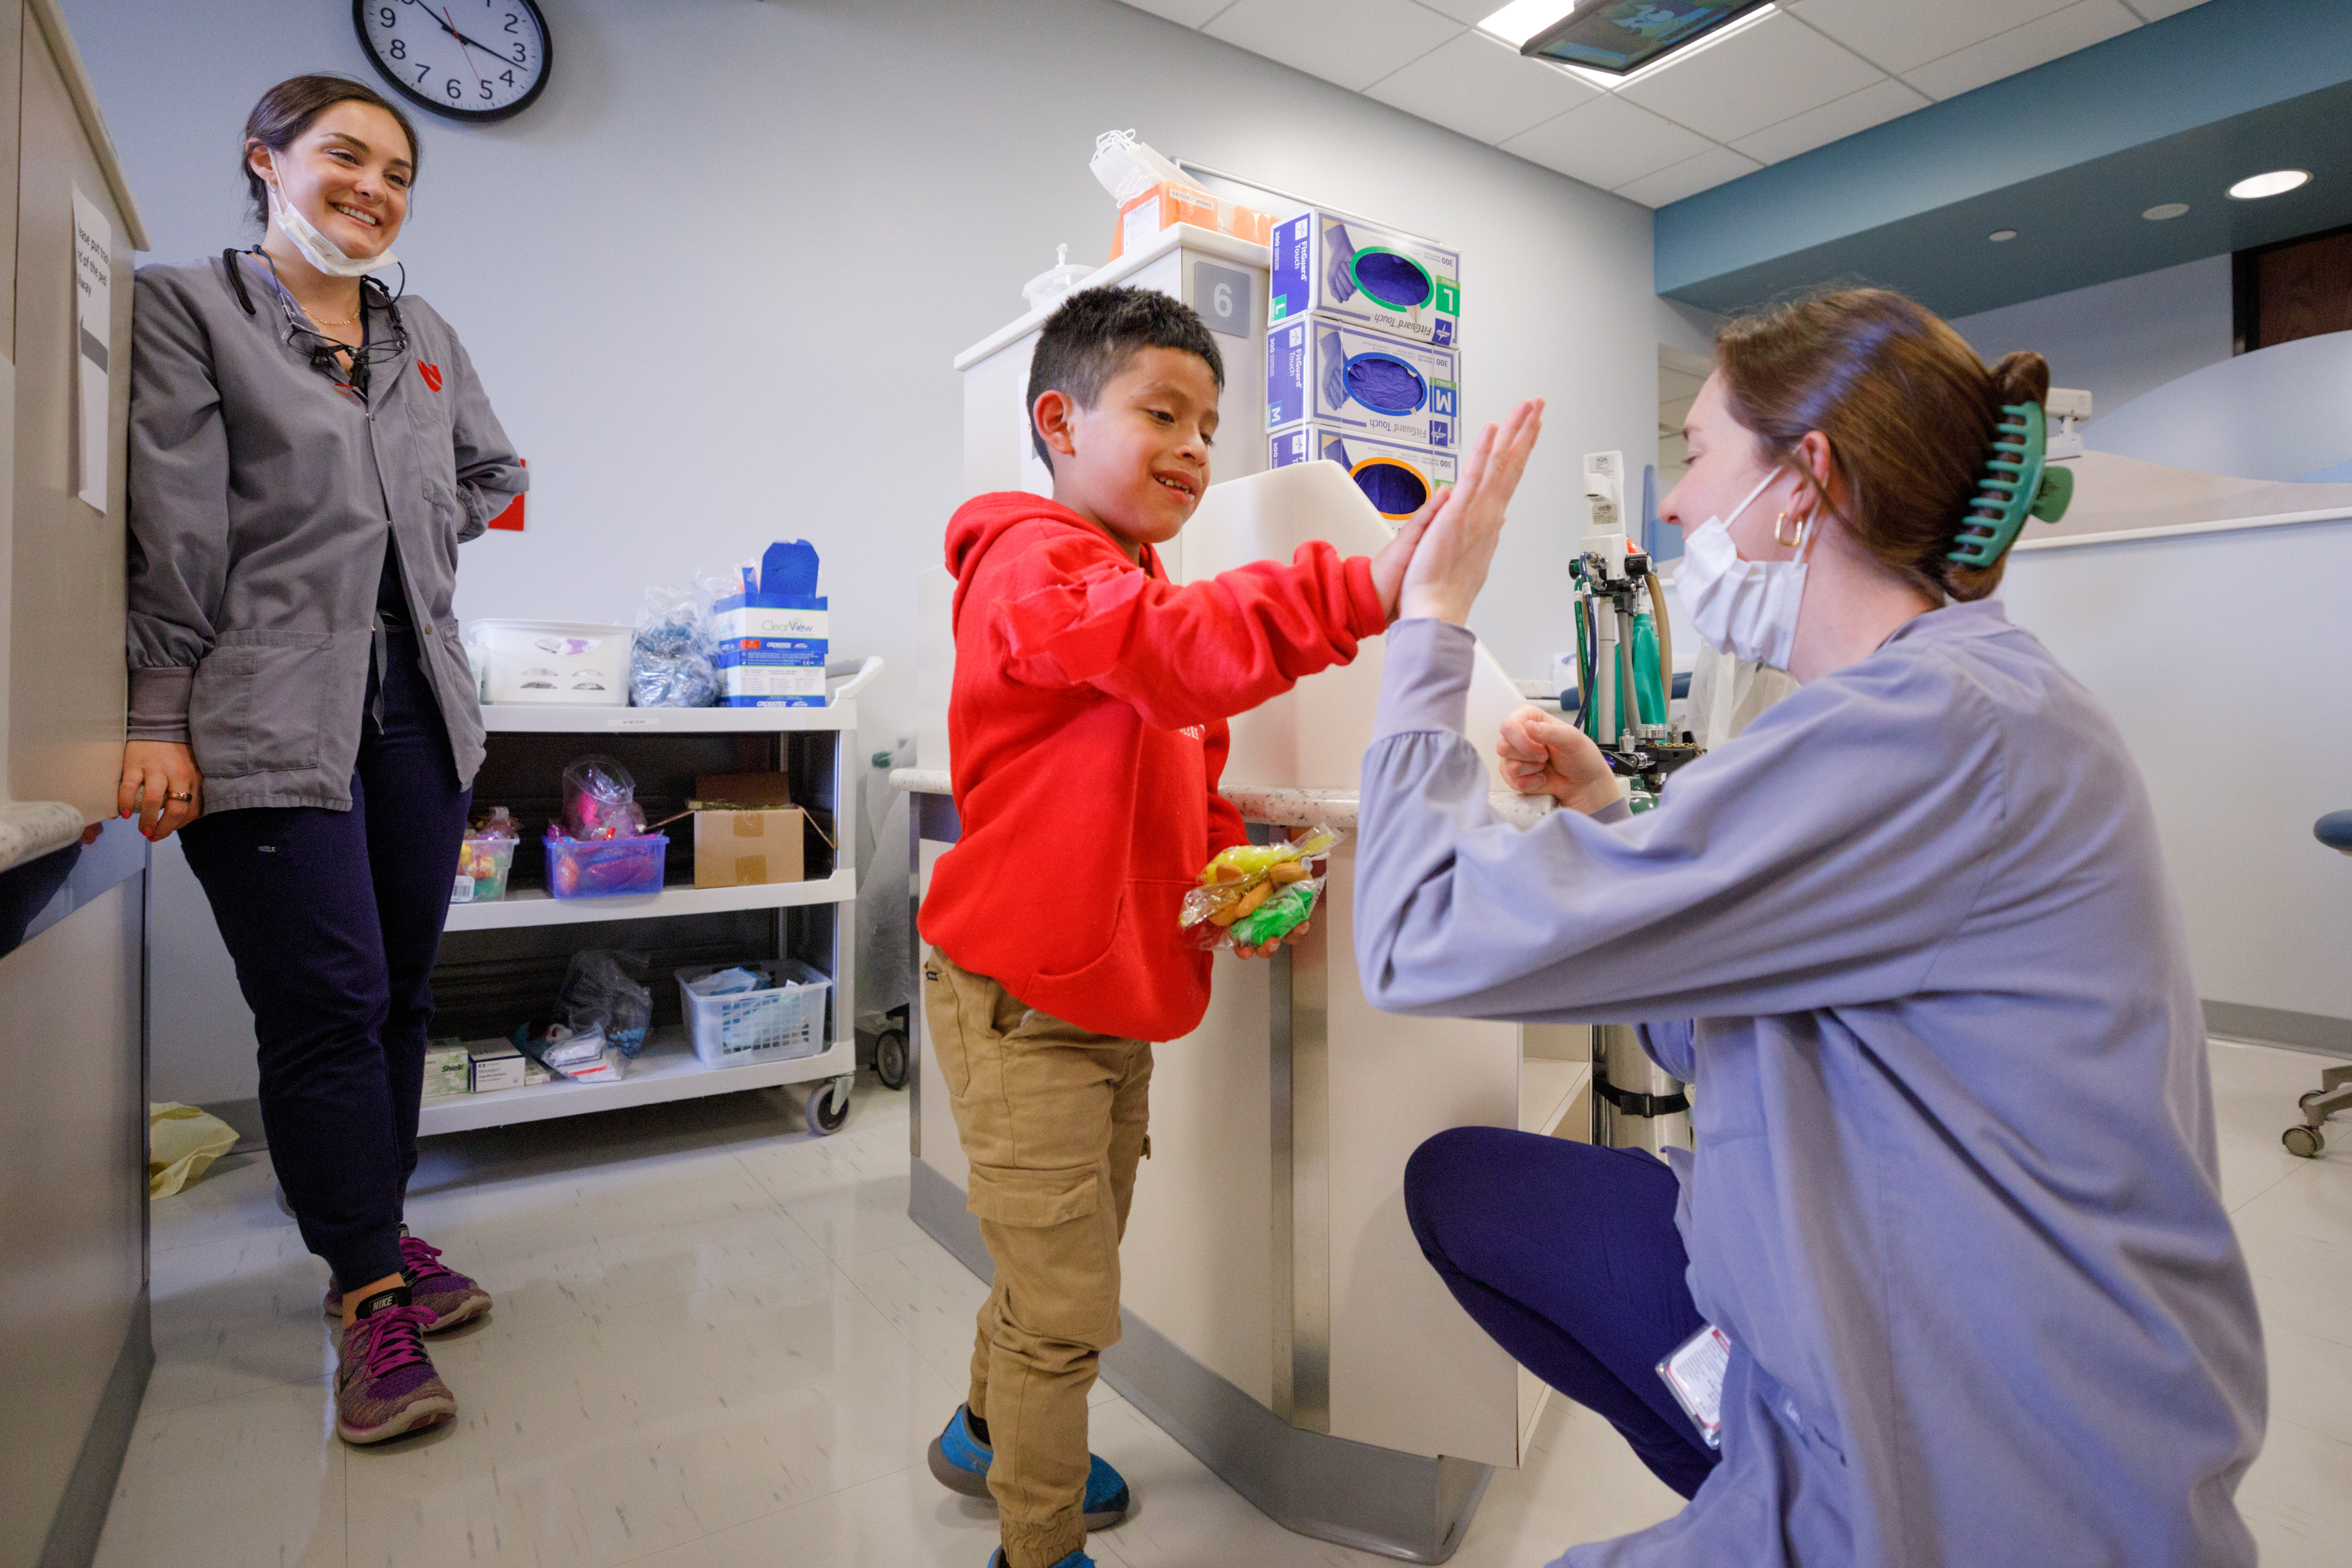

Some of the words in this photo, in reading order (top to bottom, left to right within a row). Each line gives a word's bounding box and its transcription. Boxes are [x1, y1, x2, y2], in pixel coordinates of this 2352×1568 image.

[380, 7, 396, 28] 9
[504, 13, 518, 33] 2
[390, 39, 406, 60] 8
[512, 43, 526, 63] 3
[415, 63, 431, 83] 7
[499, 69, 515, 88] 4
[446, 79, 462, 99] 6
[479, 79, 493, 99] 5
[1196, 199, 1212, 208] MASKS
[1442, 257, 1453, 267] 300
[1213, 283, 1233, 318] 6
[1443, 288, 1453, 312] L
[1275, 303, 1285, 315] L
[1375, 313, 1395, 327] Touch
[1398, 320, 1432, 336] FitGuard
[1436, 358, 1448, 367] 300
[1436, 380, 1451, 388] NITRILE
[1436, 389, 1451, 413] M
[1271, 407, 1281, 422] M
[1370, 419, 1391, 431] Touch
[1394, 424, 1426, 438] FitGuard
[1440, 460, 1452, 468] 300
[762, 619, 813, 632] ClearView
[372, 1294, 393, 1312] NIKE
